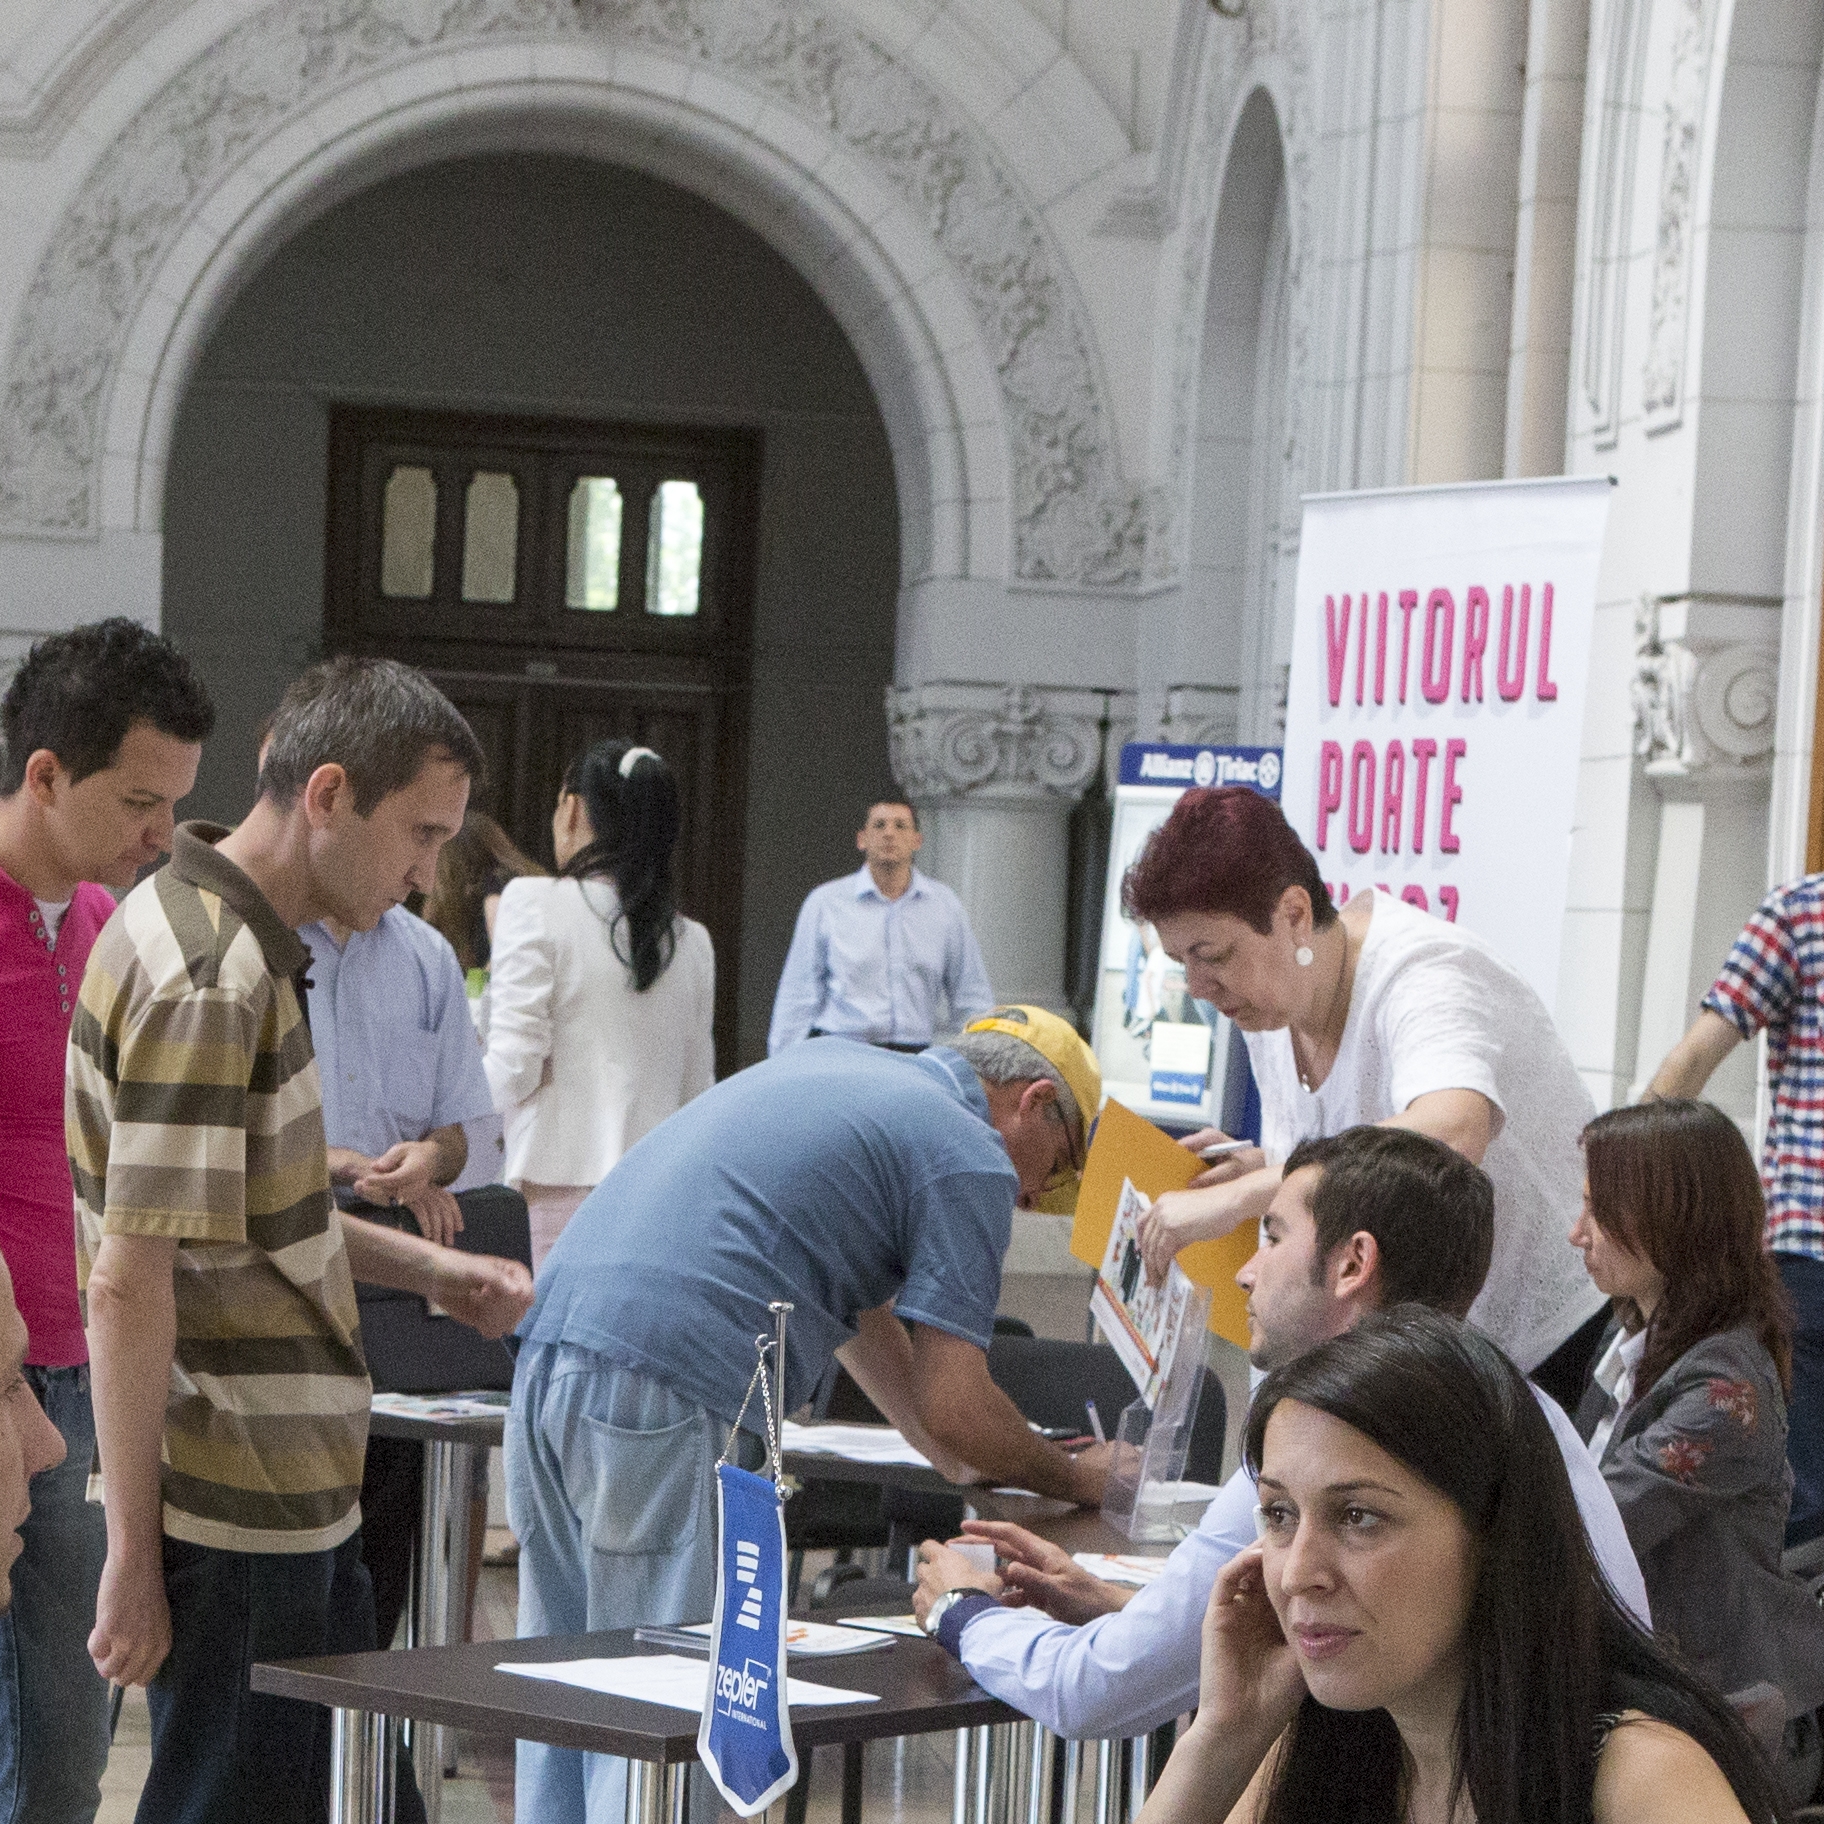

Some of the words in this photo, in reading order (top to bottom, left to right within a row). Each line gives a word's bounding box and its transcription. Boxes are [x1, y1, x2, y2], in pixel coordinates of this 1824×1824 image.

[1325, 582, 1558, 708] VIITORUL
[1139, 752, 1195, 780] Allianz
[1316, 738, 1466, 855] POATE
[716, 1657, 772, 1716] zepter
[730, 1708, 768, 1731] INTERNATIONAL
